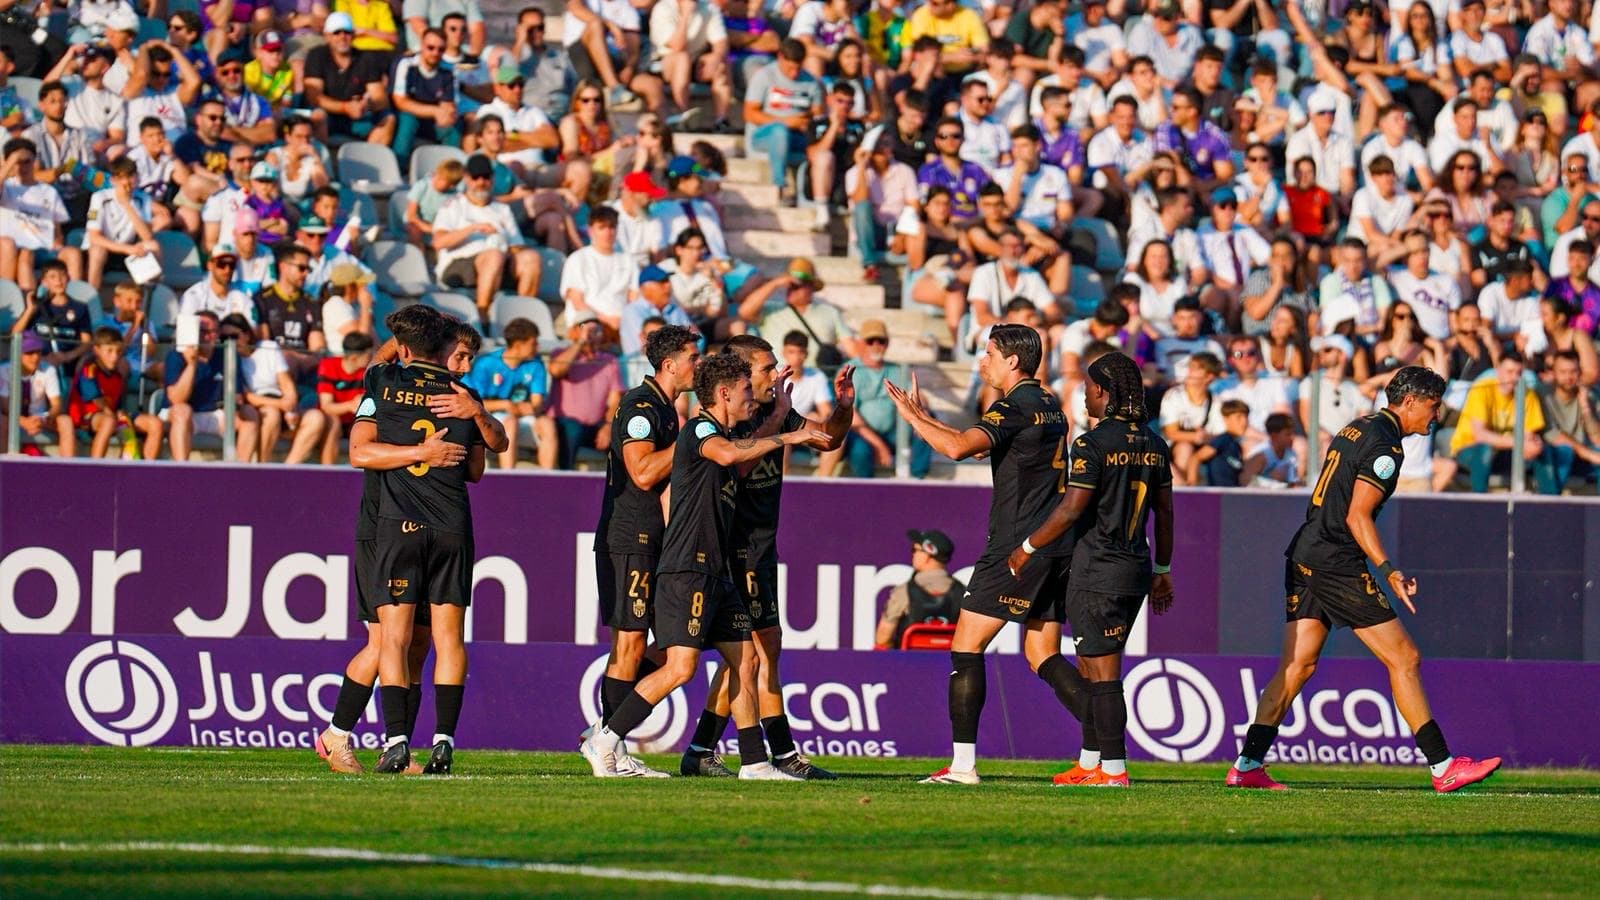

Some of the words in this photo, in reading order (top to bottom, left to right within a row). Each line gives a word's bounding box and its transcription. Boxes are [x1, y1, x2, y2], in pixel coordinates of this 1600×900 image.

[406, 418, 436, 477] 3
[1131, 480, 1148, 541] 7
[173, 525, 529, 645] Jan
[628, 570, 650, 599] 24
[746, 571, 759, 598] 6
[691, 591, 704, 618] 8
[190, 723, 389, 749] Instalacines
[1236, 739, 1429, 764] Istalaciones
